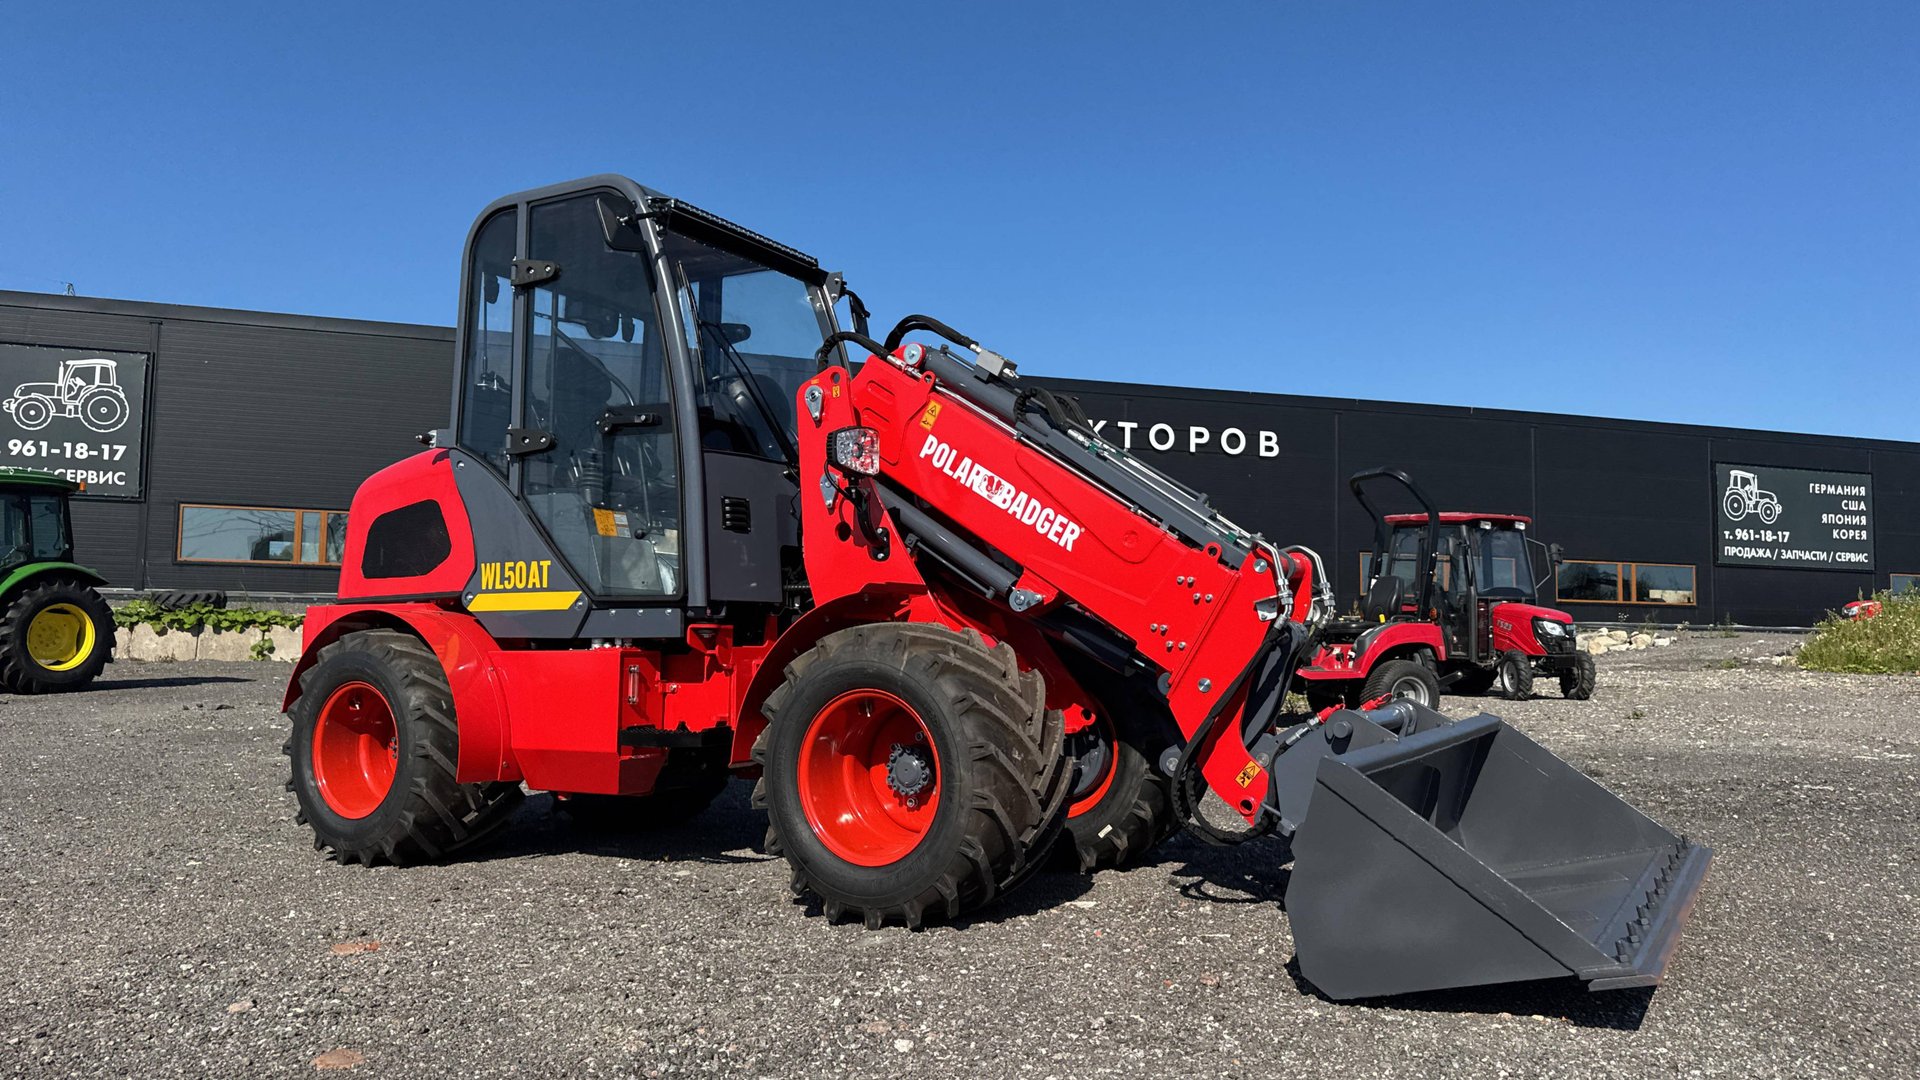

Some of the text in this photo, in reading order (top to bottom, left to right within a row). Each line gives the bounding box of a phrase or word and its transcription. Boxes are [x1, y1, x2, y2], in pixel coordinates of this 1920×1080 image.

[7, 438, 127, 461] 961-18-17
[919, 433, 1081, 552] POLAR BADGER
[1809, 483, 1866, 497] ГЕРМАНИЯ
[1841, 500, 1867, 511] США
[1821, 514, 1867, 526] ЯПОНИЯ
[1736, 528, 1790, 543] 961-18-17
[1832, 528, 1867, 541] КОРЕЯ
[1724, 546, 1772, 559] ПРОДАЖА
[1780, 549, 1827, 562] ЗАПЧАСТИ
[1835, 552, 1869, 563] СЕРВИС
[481, 560, 551, 590] WL50AT
